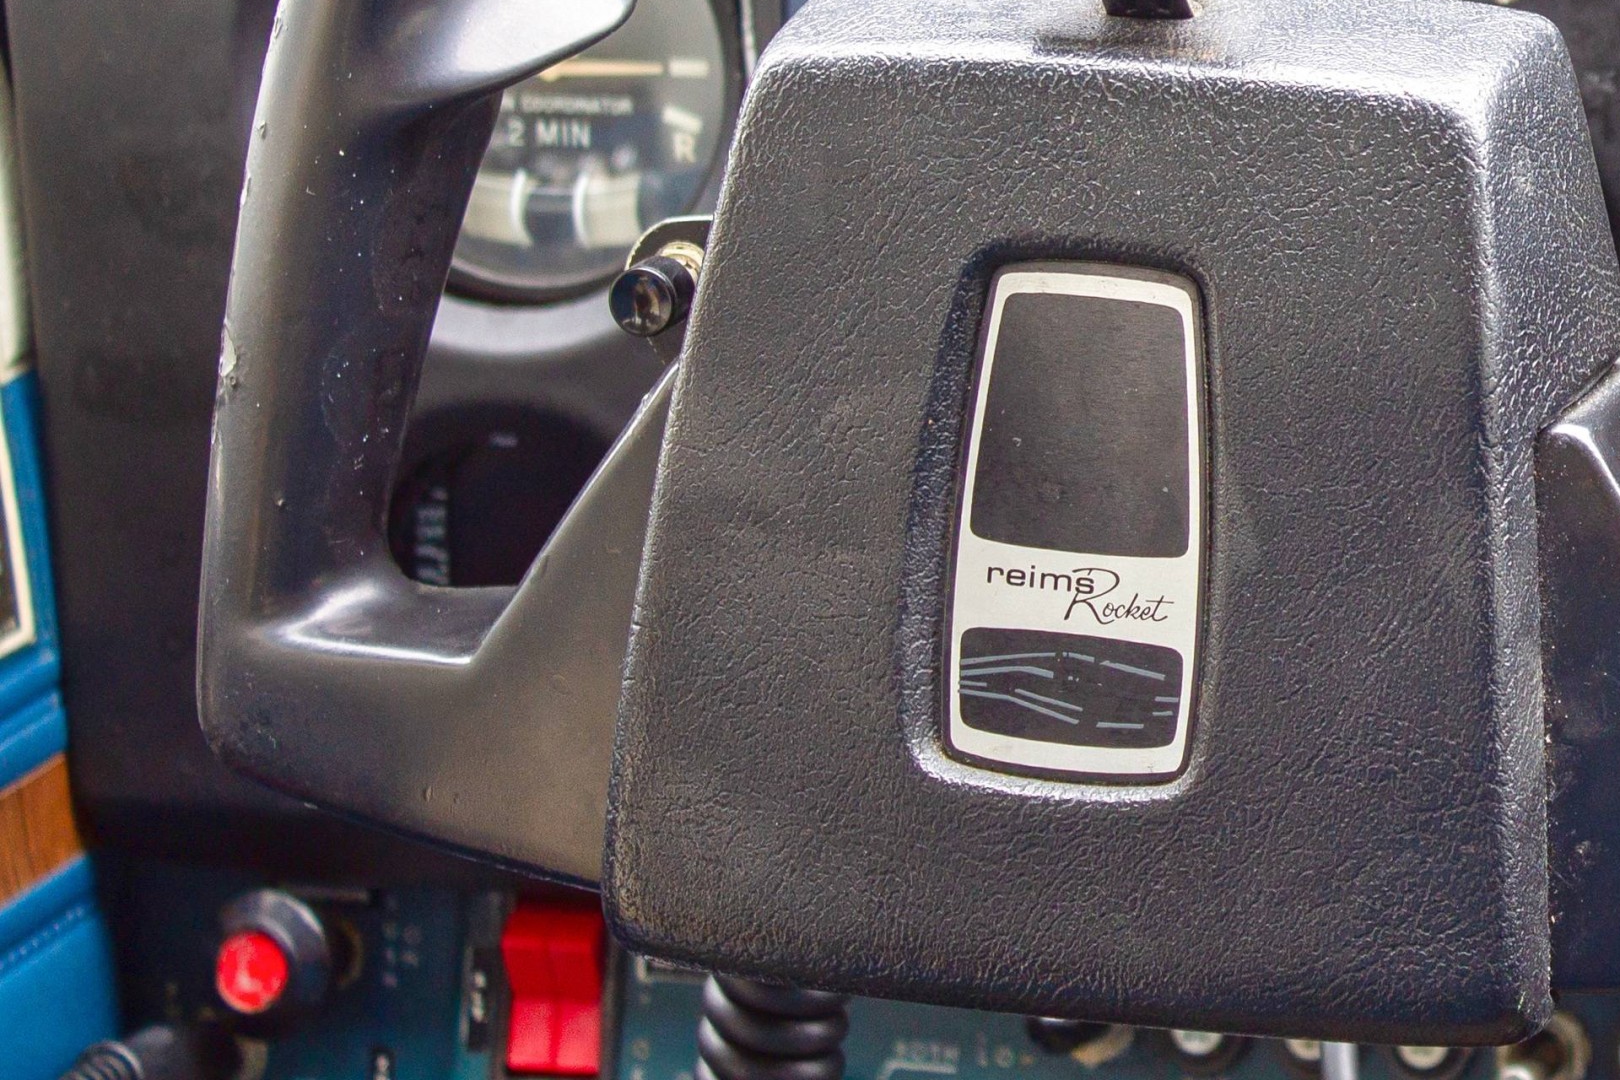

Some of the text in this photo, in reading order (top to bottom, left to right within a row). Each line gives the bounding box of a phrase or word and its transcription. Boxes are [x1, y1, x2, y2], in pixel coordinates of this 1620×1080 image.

[534, 118, 592, 149] MIN
[672, 131, 697, 164] R
[985, 563, 1175, 625] reims Rocket
